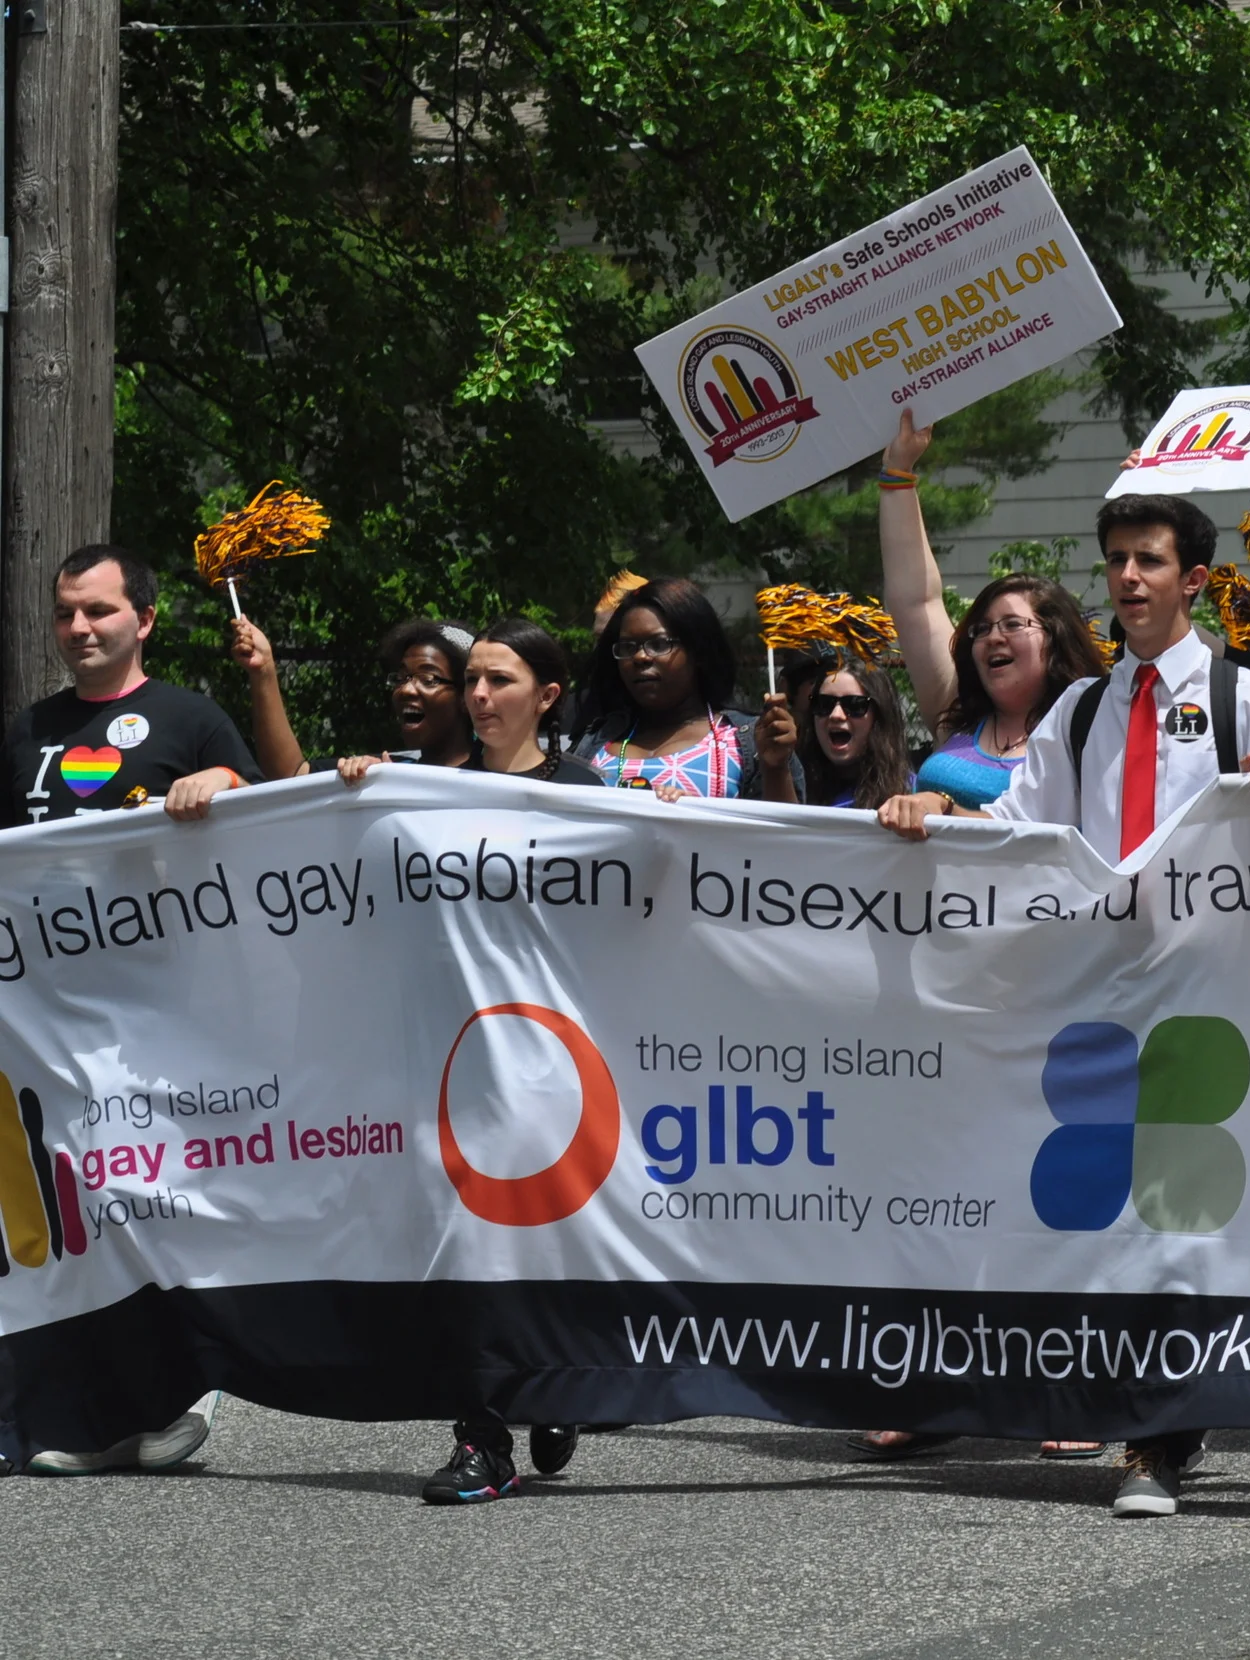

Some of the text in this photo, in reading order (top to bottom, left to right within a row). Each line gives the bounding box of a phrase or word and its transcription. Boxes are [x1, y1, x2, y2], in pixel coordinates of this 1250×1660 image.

[763, 162, 1033, 312] LIGALY's Safe Schools Initiative
[777, 201, 1005, 329] GAY-STRAIGHT ALLIANCE NETWORK
[824, 239, 1068, 382] WEST BABYLON
[901, 306, 1021, 375] HIGH SCHOOL
[686, 333, 784, 413] LONG ISLAND GAY AND LESBIAN YOUTH
[891, 313, 1054, 404] GAY-STRAIGHT ALLIANCE
[739, 403, 798, 438] ANNIVERSARY
[1178, 447, 1237, 459] ANNIVERARY
[1174, 705, 1183, 719] I
[1174, 720, 1197, 734] LI
[26, 744, 65, 800] I
[33, 863, 238, 960] island
[256, 857, 375, 937] gay,
[394, 837, 654, 918] lesbian,
[690, 852, 997, 936] bisexual
[635, 1034, 943, 1084] the long island
[82, 1073, 280, 1130] long island
[82, 1113, 403, 1191] gay and lesbian
[641, 1085, 836, 1185] glbt
[86, 1186, 193, 1240] youth
[640, 1185, 996, 1233] community center
